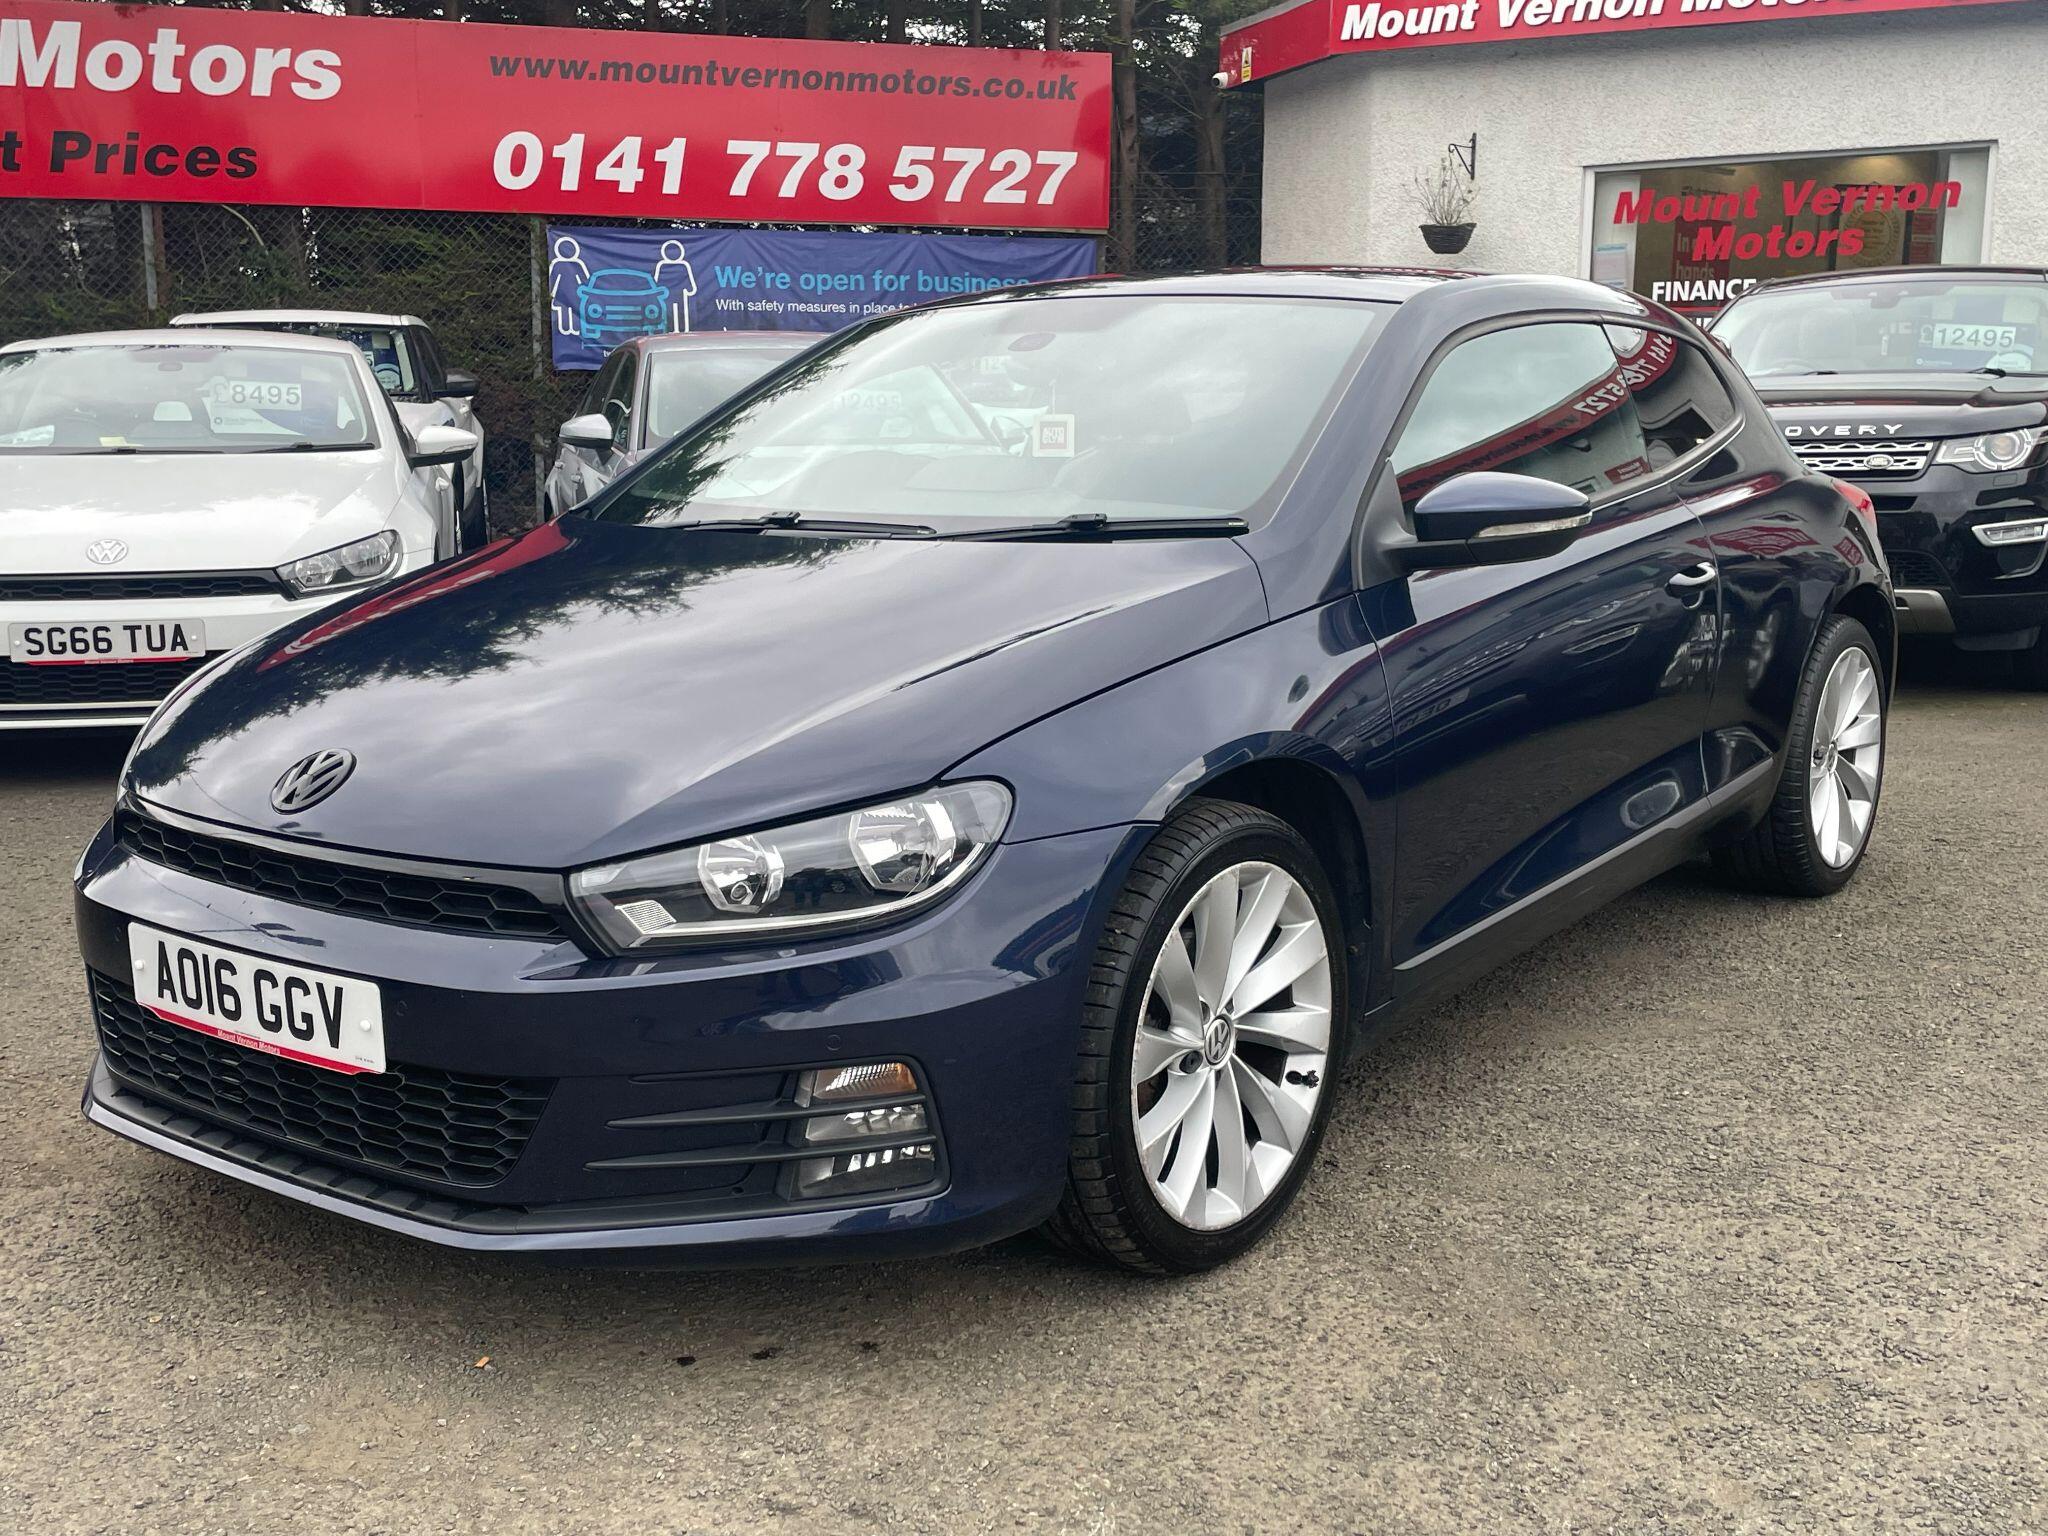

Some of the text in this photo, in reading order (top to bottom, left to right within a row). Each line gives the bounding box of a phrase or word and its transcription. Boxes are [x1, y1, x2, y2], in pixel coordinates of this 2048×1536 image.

[1341, 0, 1479, 40] Mount
[0, 19, 342, 100] Motors
[489, 55, 1077, 100] www.mountvernonmotors.co.uk
[50, 130, 258, 179] Prices
[493, 130, 1078, 205] 0141 778 5727
[1613, 179, 1962, 224] Mount Vernon
[1692, 224, 1865, 262] Motors
[714, 265, 791, 289] We're
[800, 271, 865, 296] open
[872, 269, 911, 291] for
[715, 298, 744, 311] With
[747, 299, 783, 314] safety
[787, 302, 846, 313] measures
[849, 301, 860, 313] in
[863, 302, 896, 315] place
[24, 624, 189, 656] SG66 TUA
[158, 940, 343, 1049] AO16 GGV
